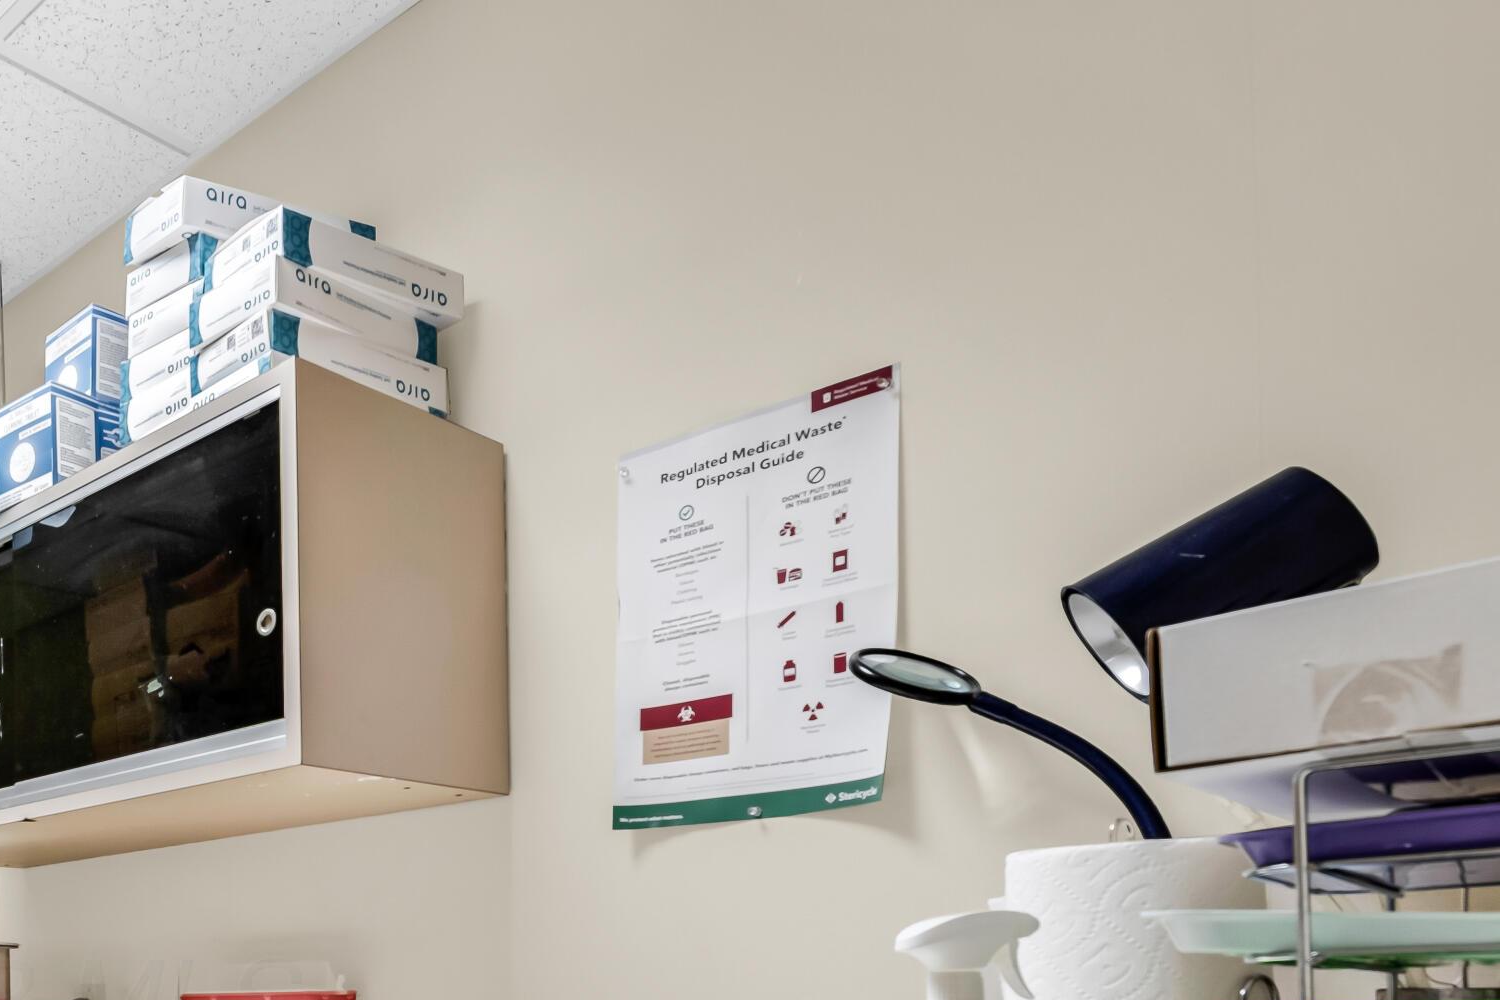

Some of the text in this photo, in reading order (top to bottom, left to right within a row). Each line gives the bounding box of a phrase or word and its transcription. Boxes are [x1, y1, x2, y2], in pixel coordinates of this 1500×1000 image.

[206, 186, 247, 210] aira
[295, 268, 332, 295] aira
[411, 282, 447, 306] aira
[395, 379, 430, 402] aira
[660, 453, 728, 484] Regulated
[732, 434, 791, 460] Medical
[695, 448, 805, 489] Disposal Guide
[809, 486, 825, 496] PUT
[827, 478, 852, 490] THESE
